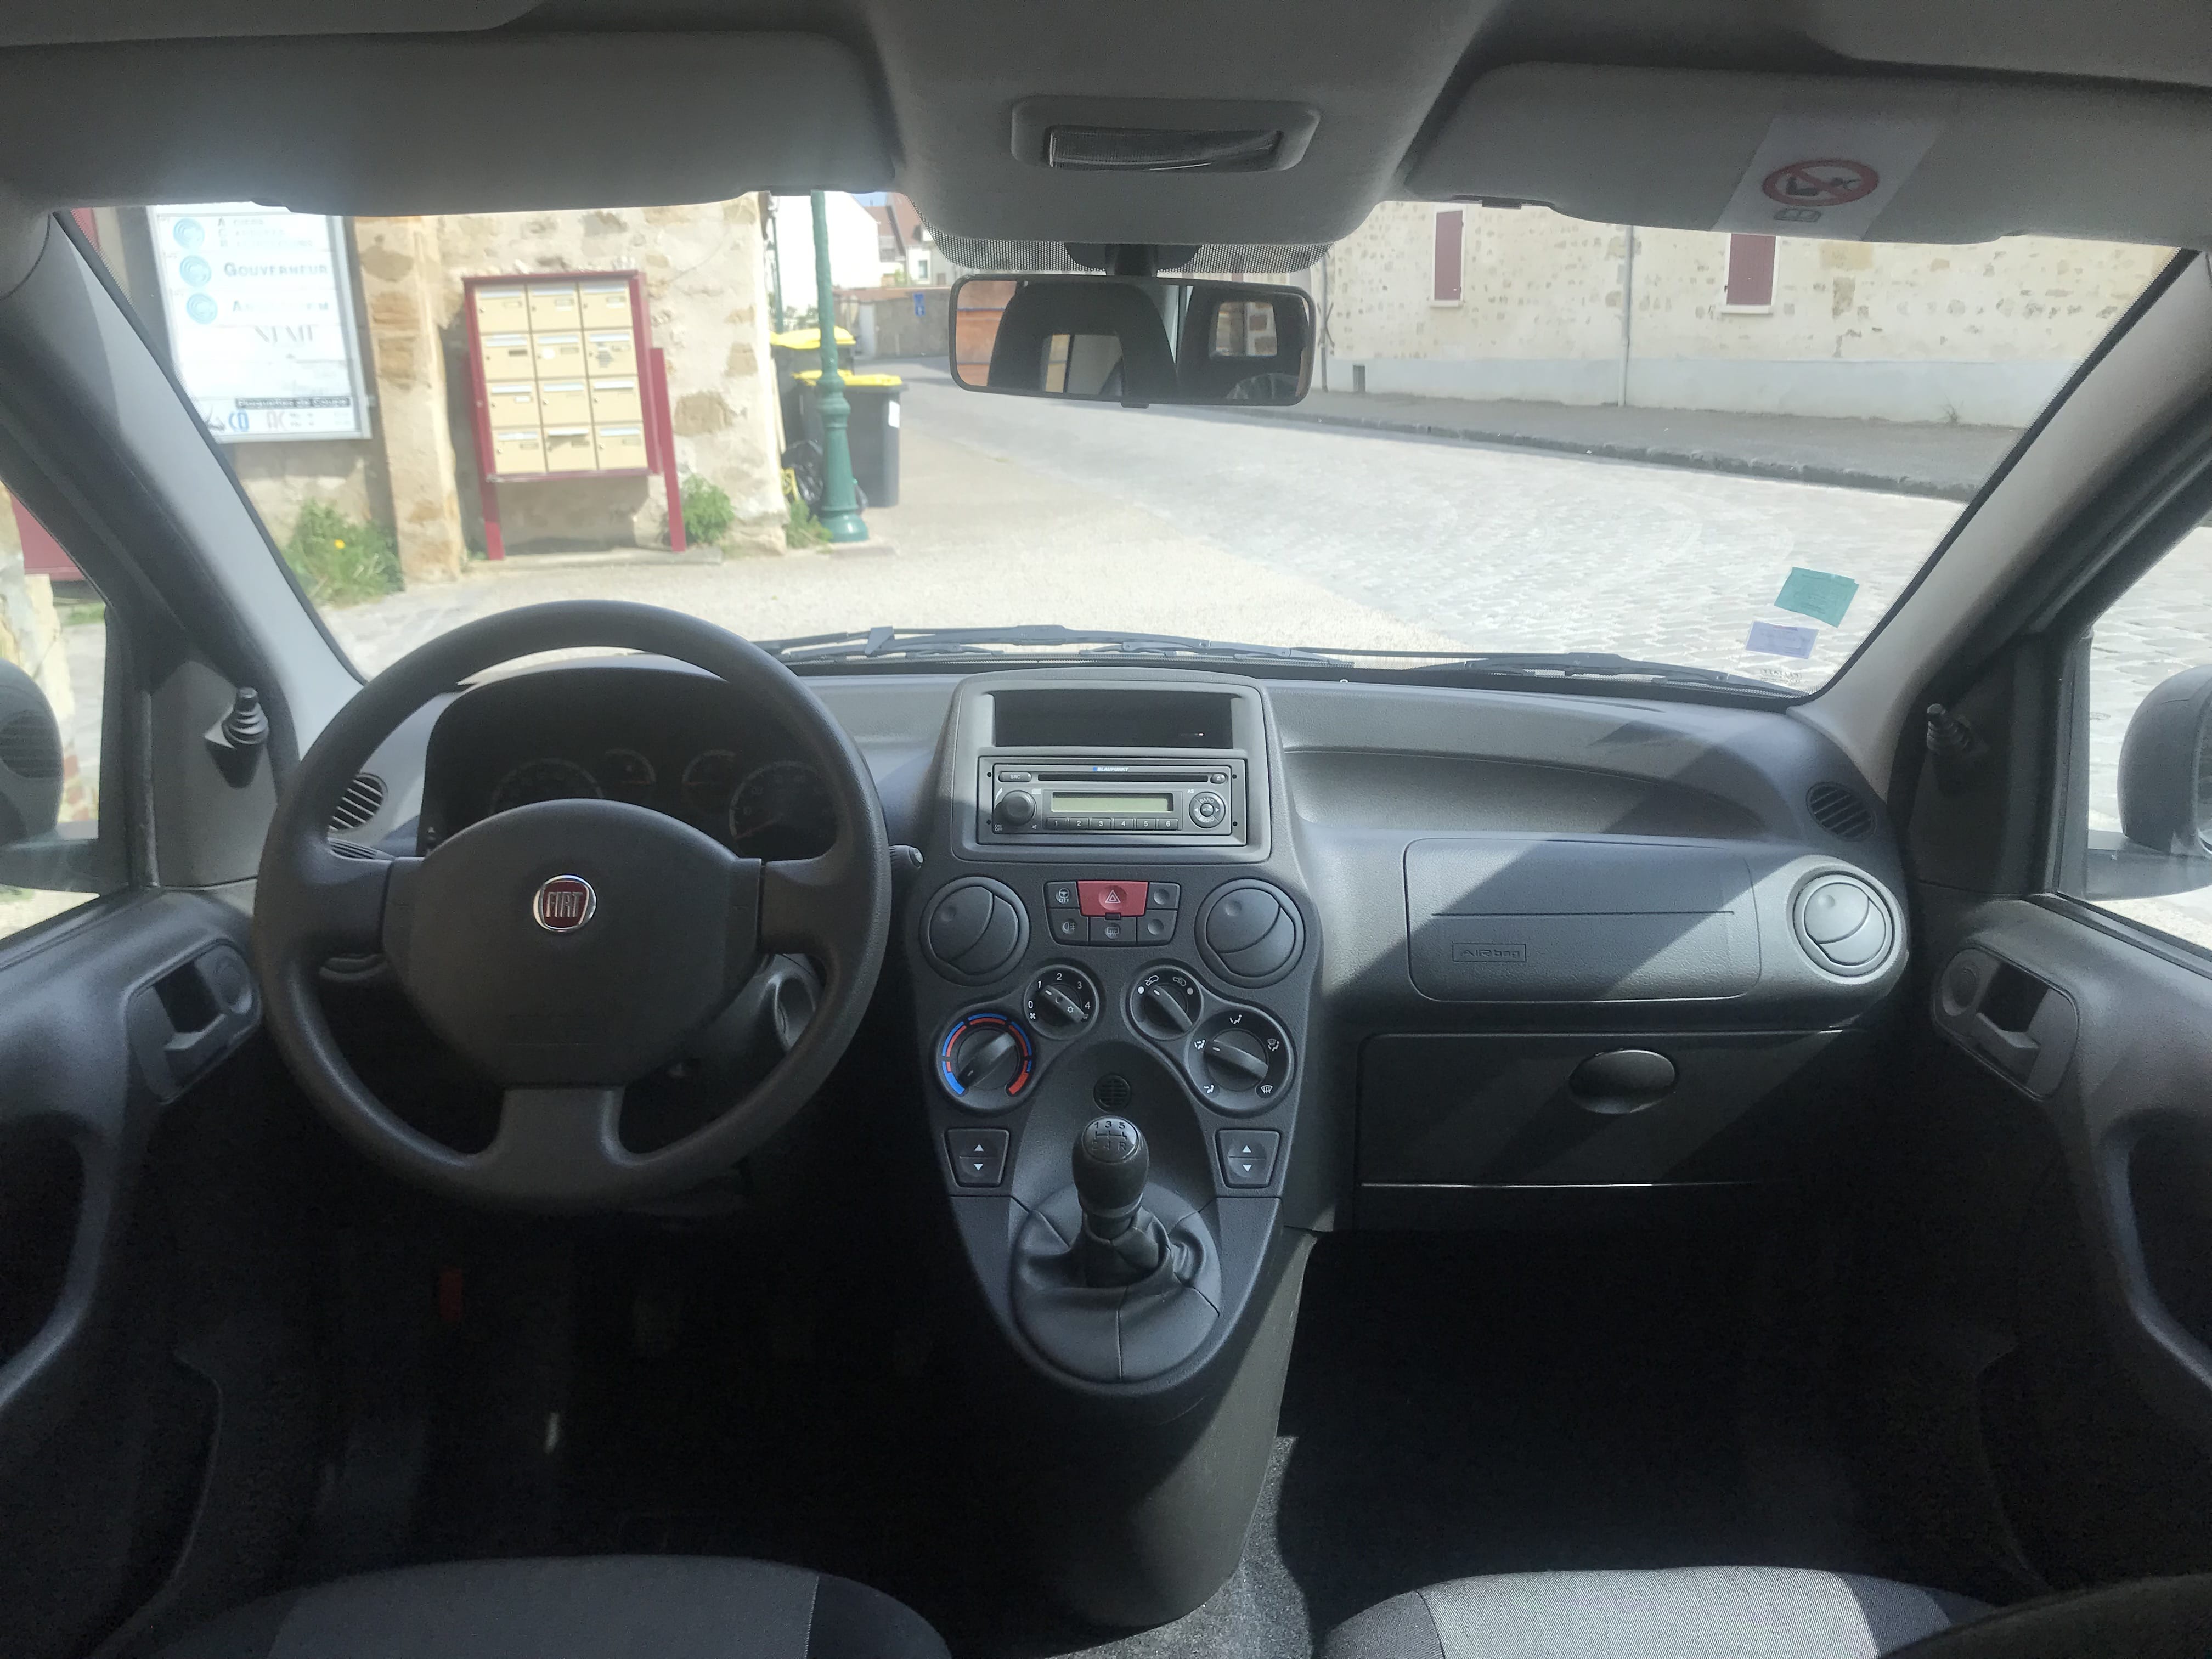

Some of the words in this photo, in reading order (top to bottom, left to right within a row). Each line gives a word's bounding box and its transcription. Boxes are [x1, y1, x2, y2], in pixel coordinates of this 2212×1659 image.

[545, 891, 583, 918] FIAT
[1038, 980, 1041, 989] 1
[1028, 1000, 1033, 1008] 0
[1085, 1001, 1091, 1009] 4
[1118, 1141, 1126, 1151] R
